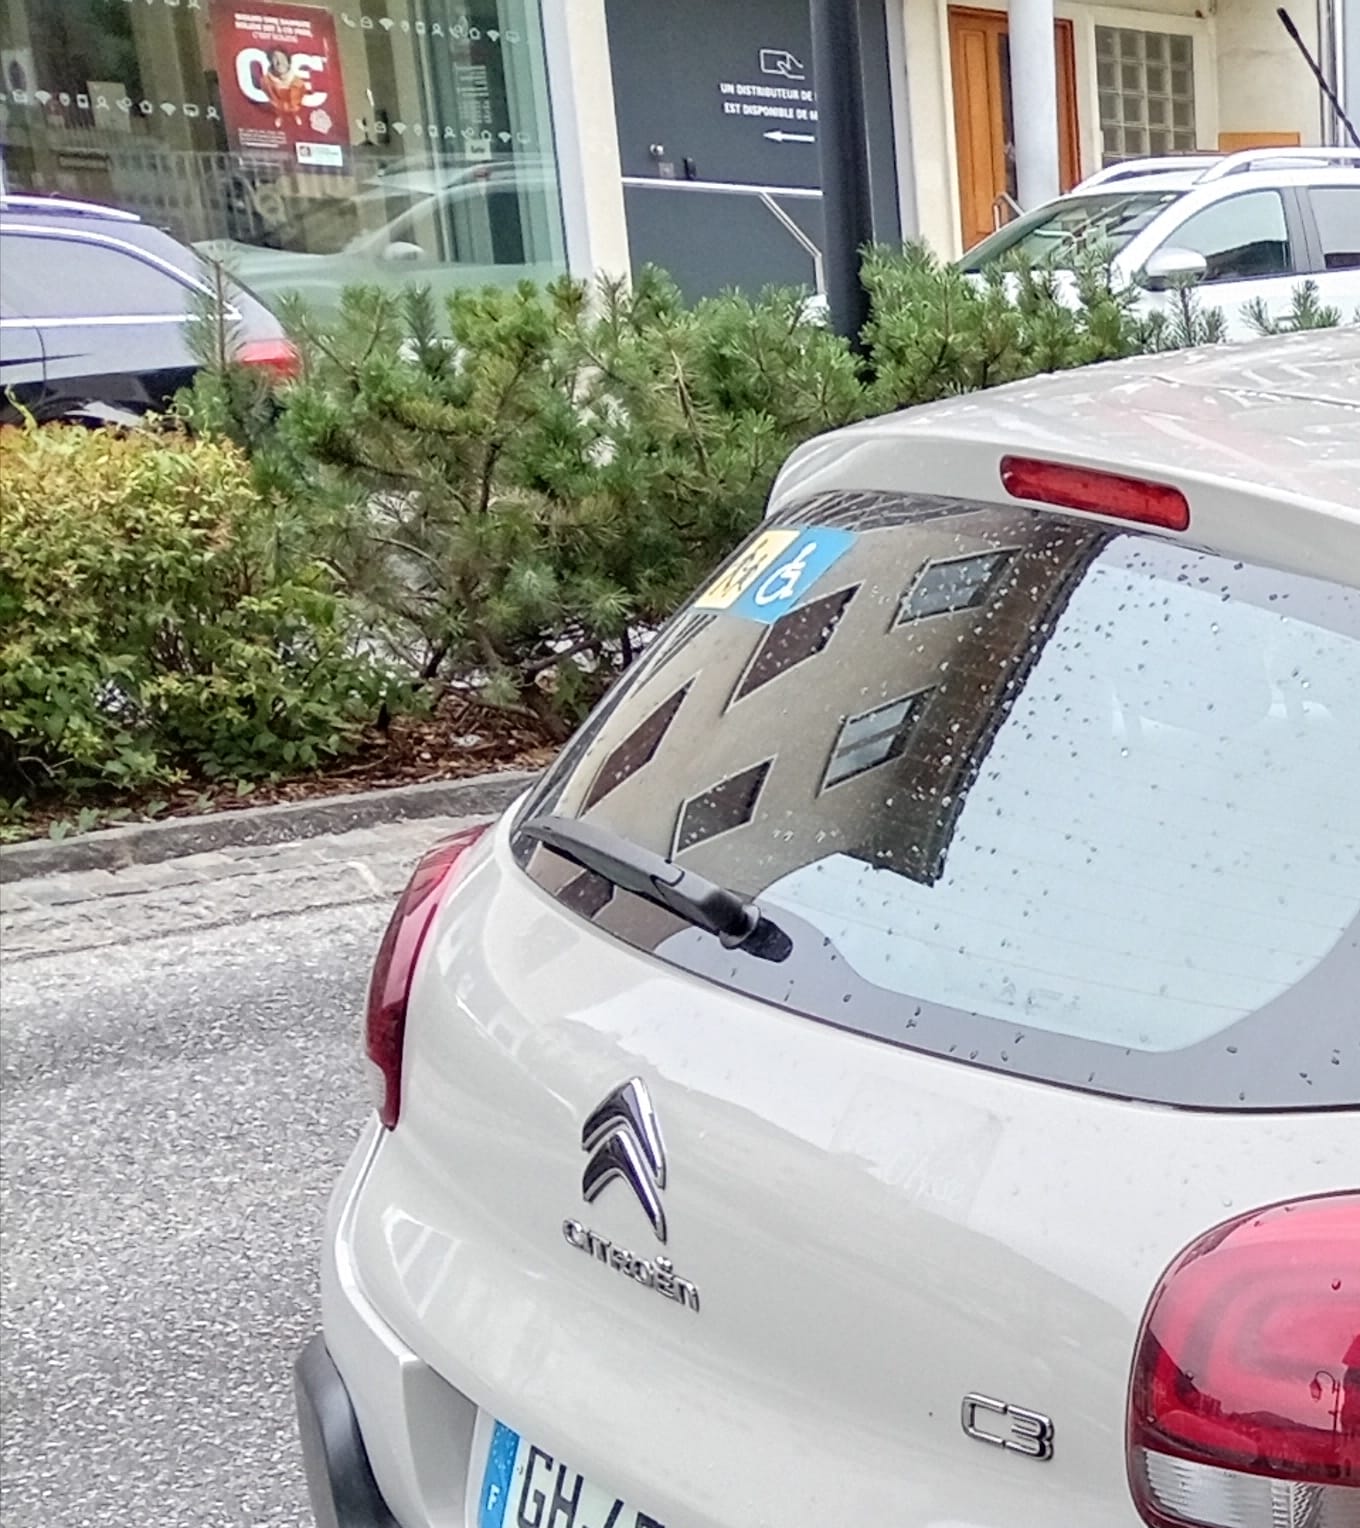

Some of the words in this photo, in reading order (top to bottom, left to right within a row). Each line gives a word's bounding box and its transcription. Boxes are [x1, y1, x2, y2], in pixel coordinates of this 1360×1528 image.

[719, 82, 735, 94] UN
[736, 83, 800, 99] DISTRIBUTEUR
[723, 102, 741, 114] EST
[742, 104, 795, 119] DISPONIBLE
[961, 1391, 1055, 1461] C3
[487, 1483, 500, 1511] F
